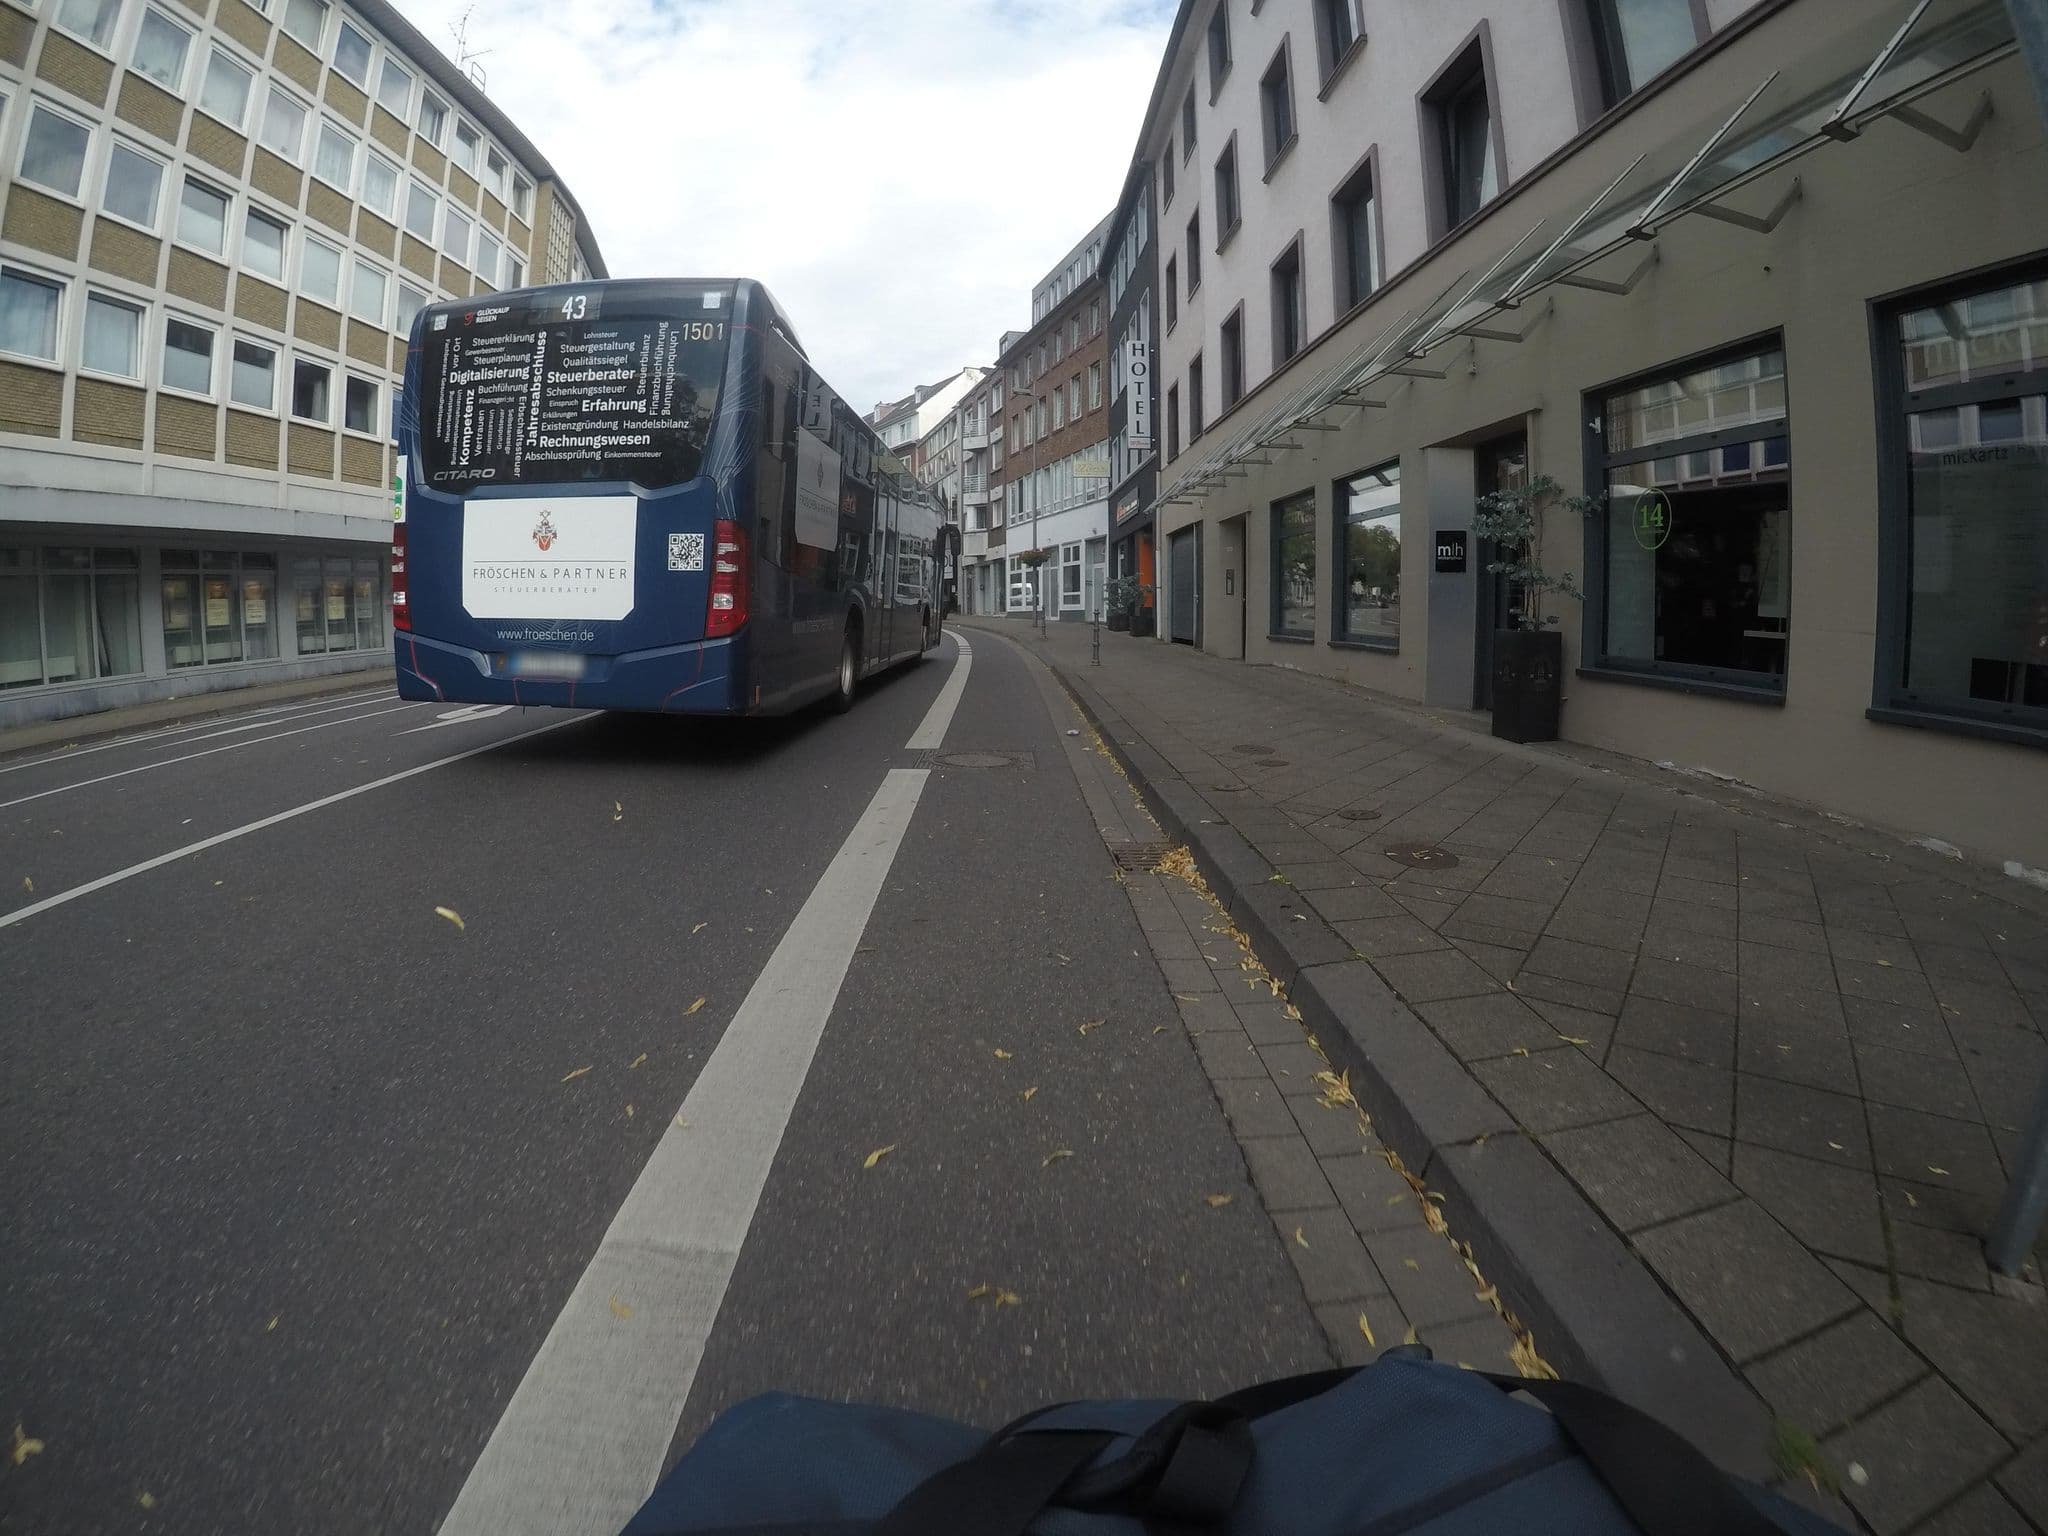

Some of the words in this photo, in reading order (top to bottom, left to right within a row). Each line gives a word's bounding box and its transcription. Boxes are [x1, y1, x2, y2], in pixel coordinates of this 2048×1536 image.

[476, 306, 510, 316] GLÜCKAUF
[562, 295, 587, 320] 43
[476, 316, 498, 324] REISEN
[584, 332, 618, 340] Lohnsteuer
[682, 322, 724, 341] 1501
[454, 338, 462, 352] Ort
[472, 333, 536, 346] Steuererklärung
[560, 342, 636, 354] Steuergestaltung
[474, 354, 531, 366] Steuerplanung
[563, 355, 628, 368] Qualitätssiegel
[637, 334, 651, 395] Steuerbilanz
[450, 366, 530, 385] Digitalisierung
[547, 368, 636, 384] Steuerberater
[650, 322, 668, 416] Finanzbuchführung
[661, 330, 680, 416] Lohnbuchhaltung
[478, 383, 528, 394] Buchführung
[526, 331, 547, 446] Jahresabschluss
[546, 385, 627, 396] Schenkungssteuer
[1131, 343, 1147, 435] HOTEL
[549, 399, 578, 408] Einspruch
[582, 398, 647, 413] Erfahrung
[542, 411, 578, 419] Erklärungen
[460, 388, 474, 466] Kompetenz
[496, 408, 505, 450] Grundsteuer
[541, 420, 619, 432] Existenzgründung
[623, 419, 690, 430] Handelsbilanz
[474, 410, 486, 456] Vertrauen
[514, 396, 528, 478] Erbschaftssteuer
[540, 434, 650, 448] Rechnungswesen
[525, 450, 602, 461] Abschlussprüfung
[604, 451, 662, 459] Einkommensteuer
[434, 468, 496, 481] CITARO
[1640, 502, 1664, 528] 14
[474, 566, 535, 579] FRÖSCHEN
[540, 568, 548, 579] &
[554, 568, 627, 579] PARTNER
[497, 628, 594, 642] www.froeschen.de
